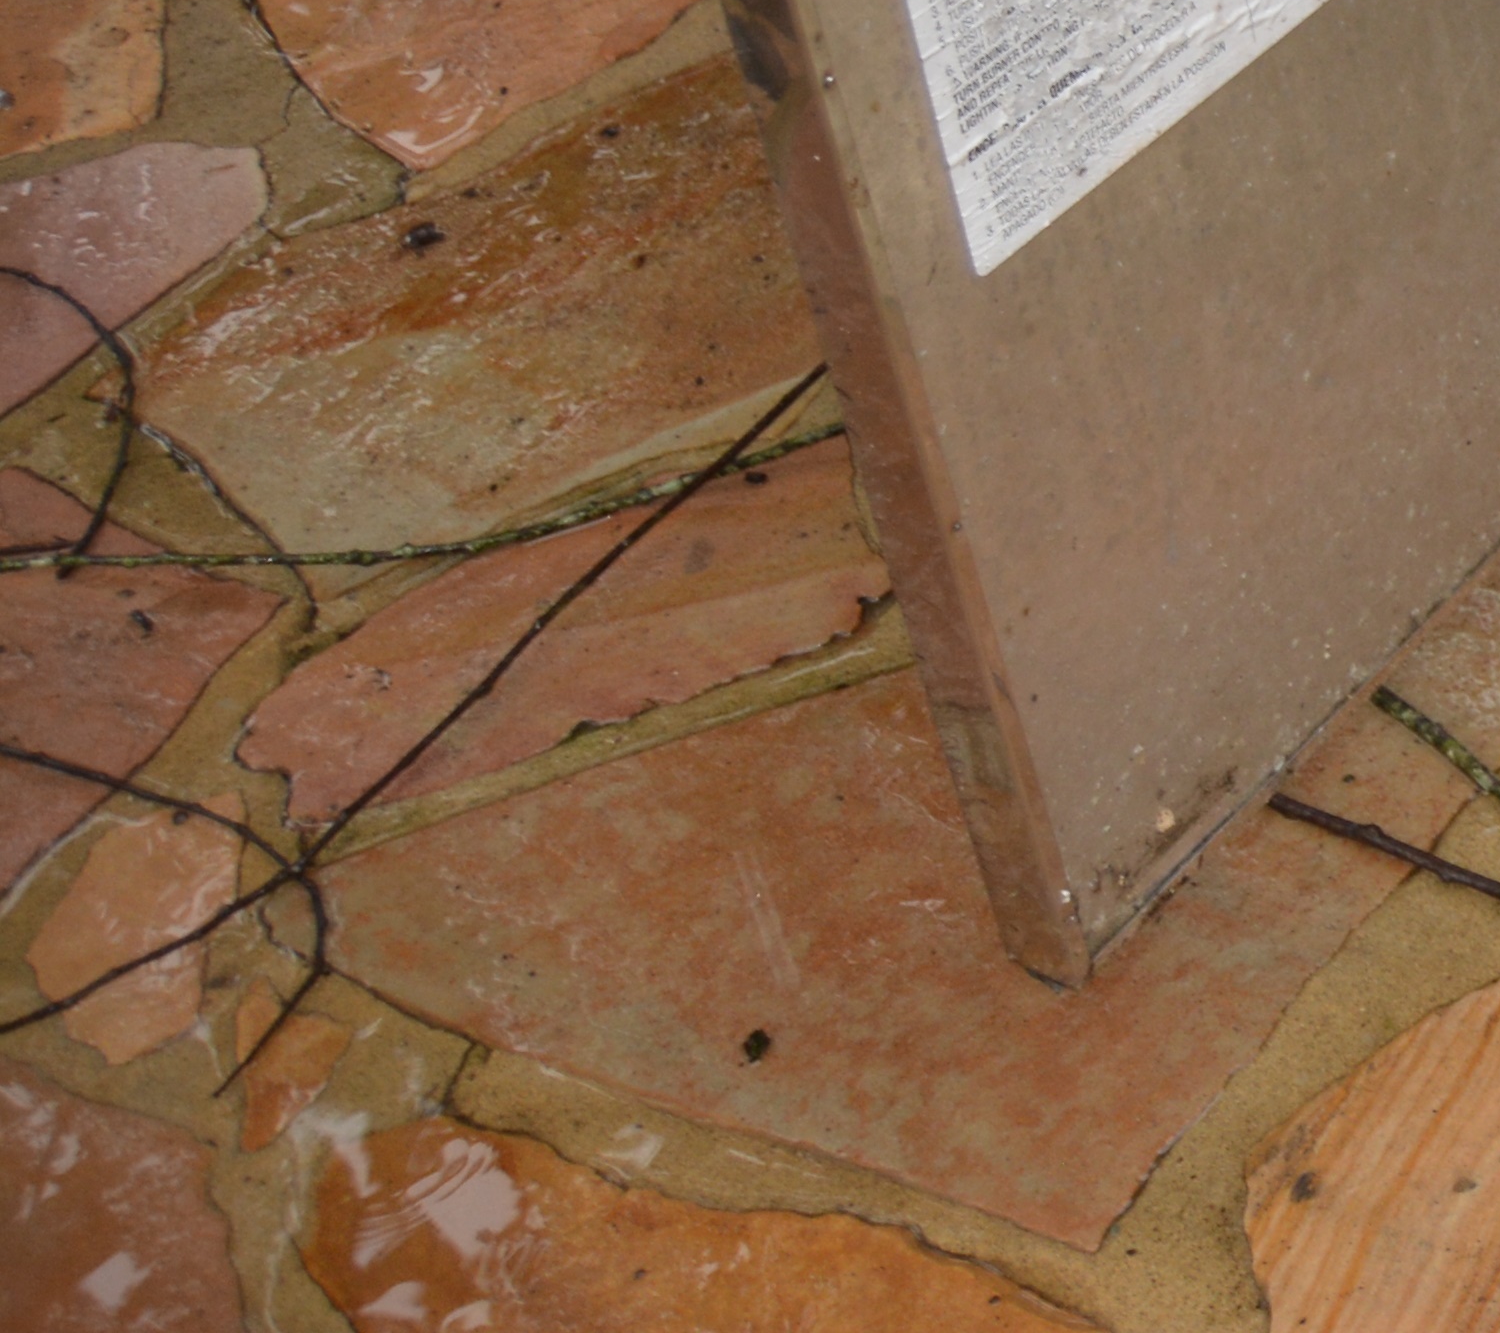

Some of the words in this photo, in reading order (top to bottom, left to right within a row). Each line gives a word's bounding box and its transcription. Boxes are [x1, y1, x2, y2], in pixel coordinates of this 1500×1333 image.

[953, 78, 980, 107] TURN
[981, 47, 1020, 85] BURNER
[956, 95, 977, 121] AND
